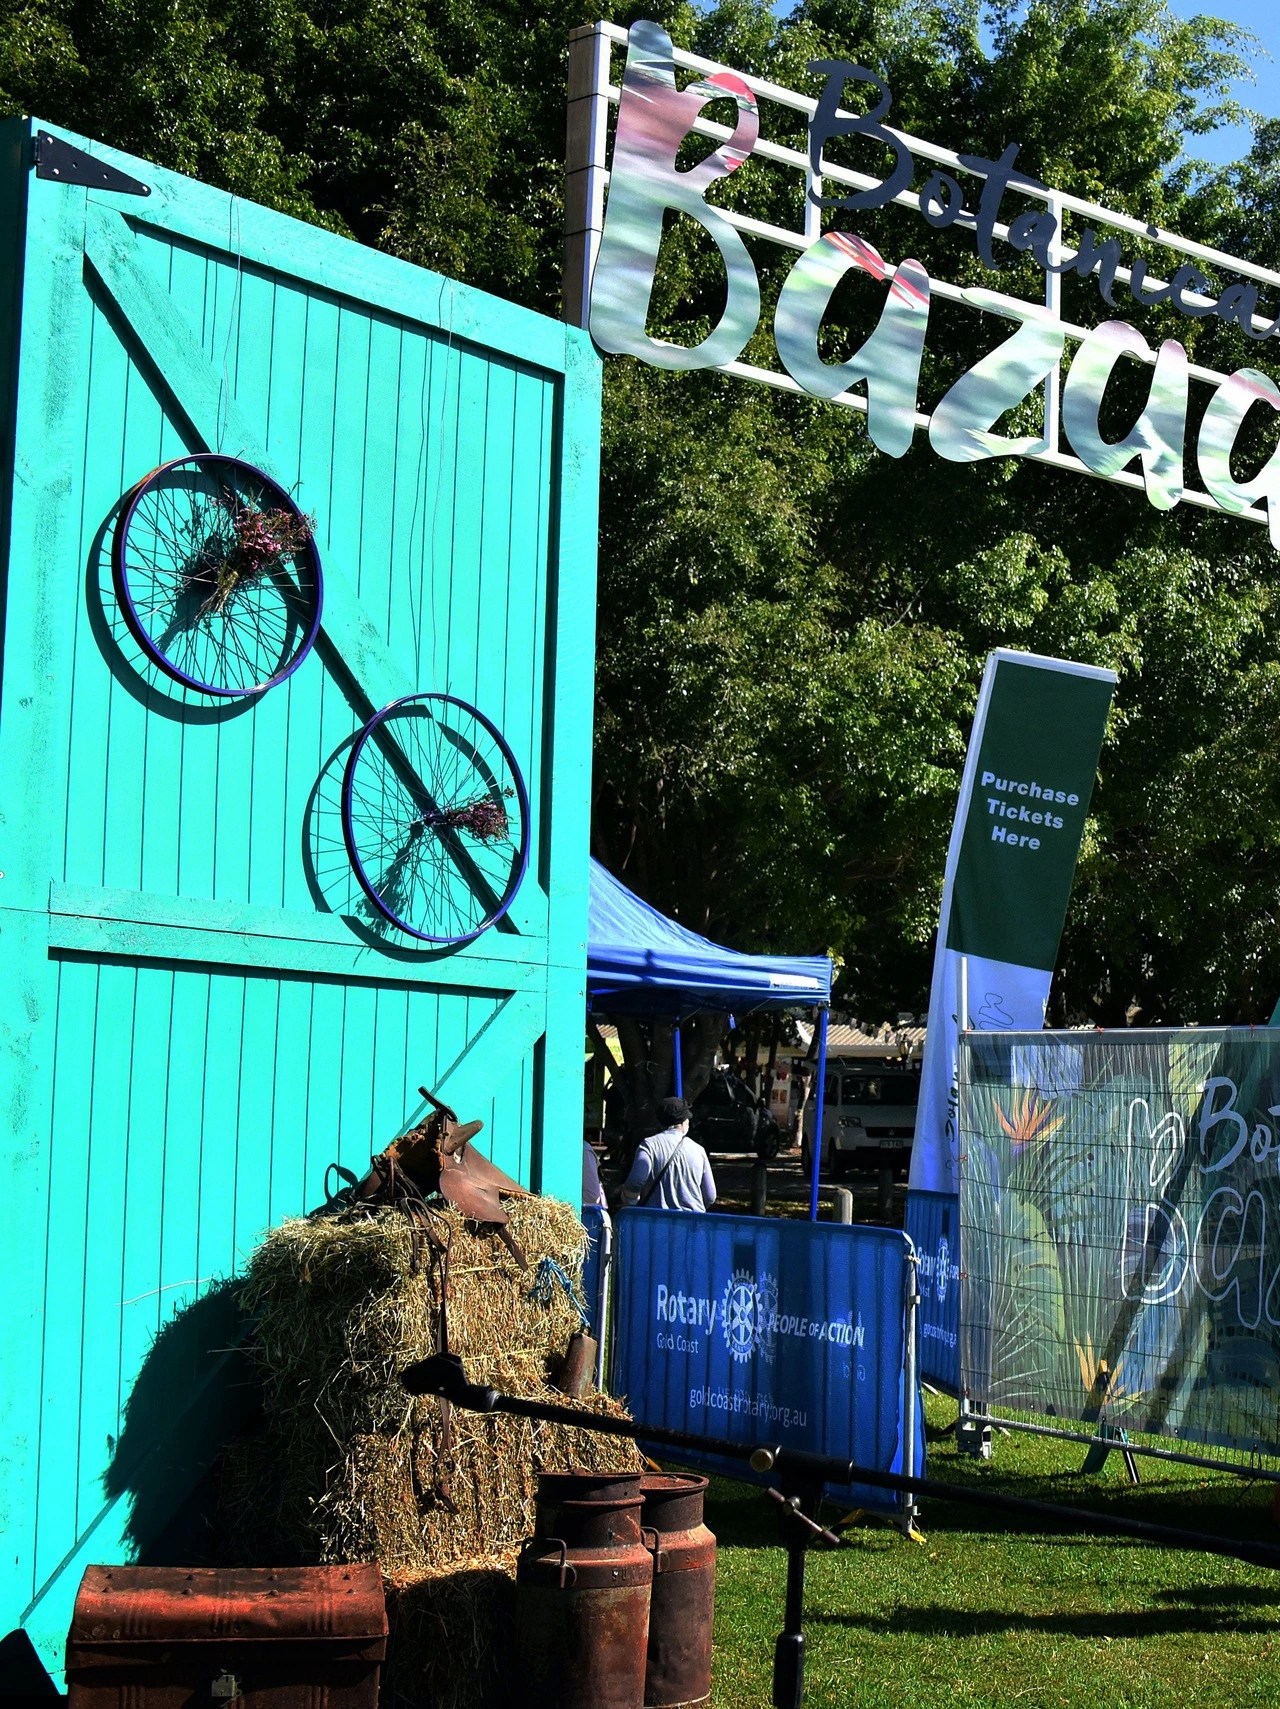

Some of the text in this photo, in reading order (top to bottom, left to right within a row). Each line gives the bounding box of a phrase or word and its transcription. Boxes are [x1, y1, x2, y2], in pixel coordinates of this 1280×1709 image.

[981, 771, 1080, 806] Purchase
[987, 797, 1064, 829] Tickets
[991, 825, 1041, 850] Here
[657, 1284, 717, 1335] Rotary
[676, 1335, 699, 1354] Coast
[767, 1312, 865, 1348] PEOPLE OF ACTION
